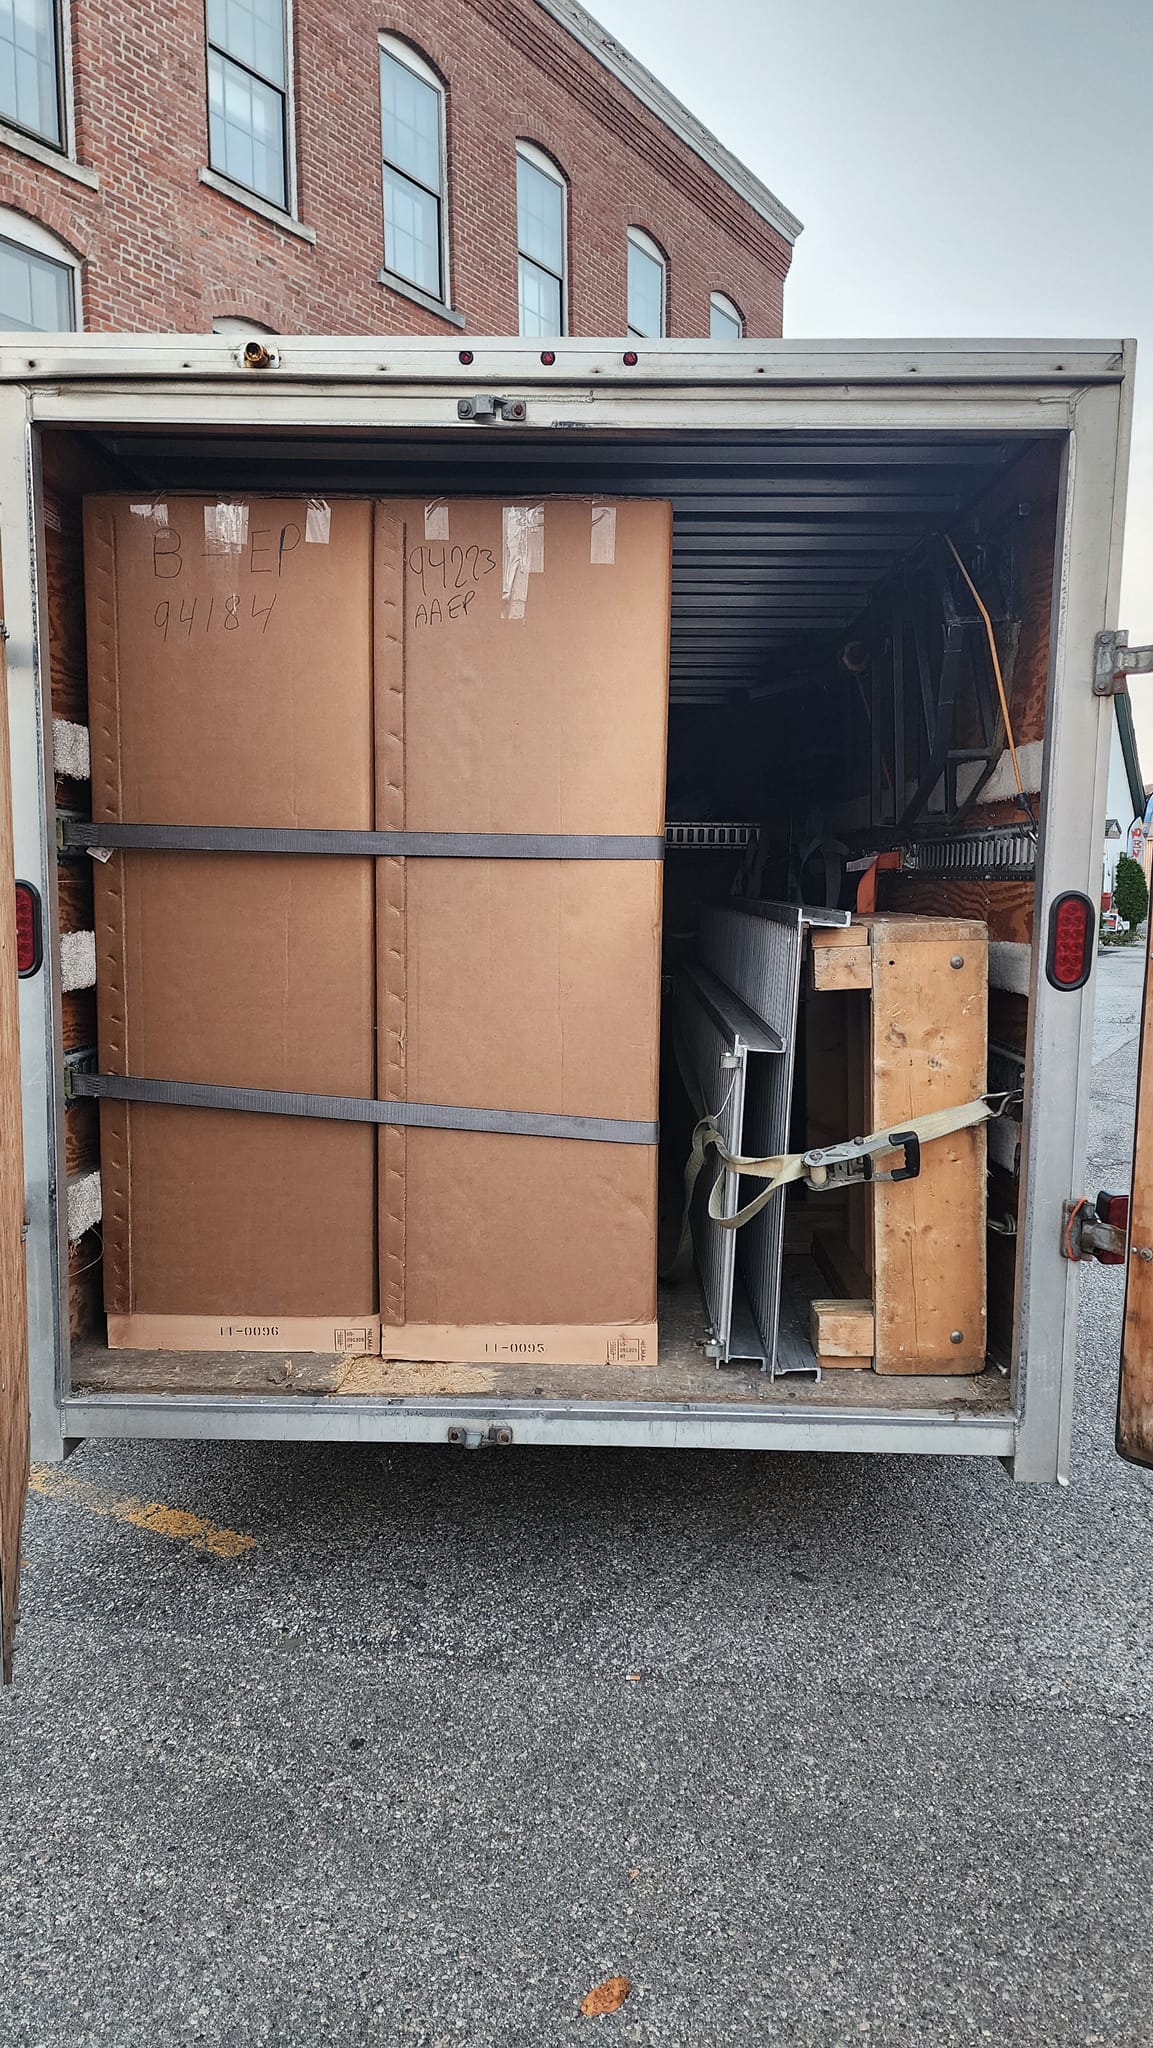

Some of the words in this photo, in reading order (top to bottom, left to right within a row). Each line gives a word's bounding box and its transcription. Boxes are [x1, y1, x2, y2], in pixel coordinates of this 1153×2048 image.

[408, 544, 497, 597] 94223
[154, 593, 277, 642] 94184
[414, 590, 476, 628] AAEP
[219, 1326, 280, 1337] 11-0096
[484, 1343, 545, 1354] 11-0095
